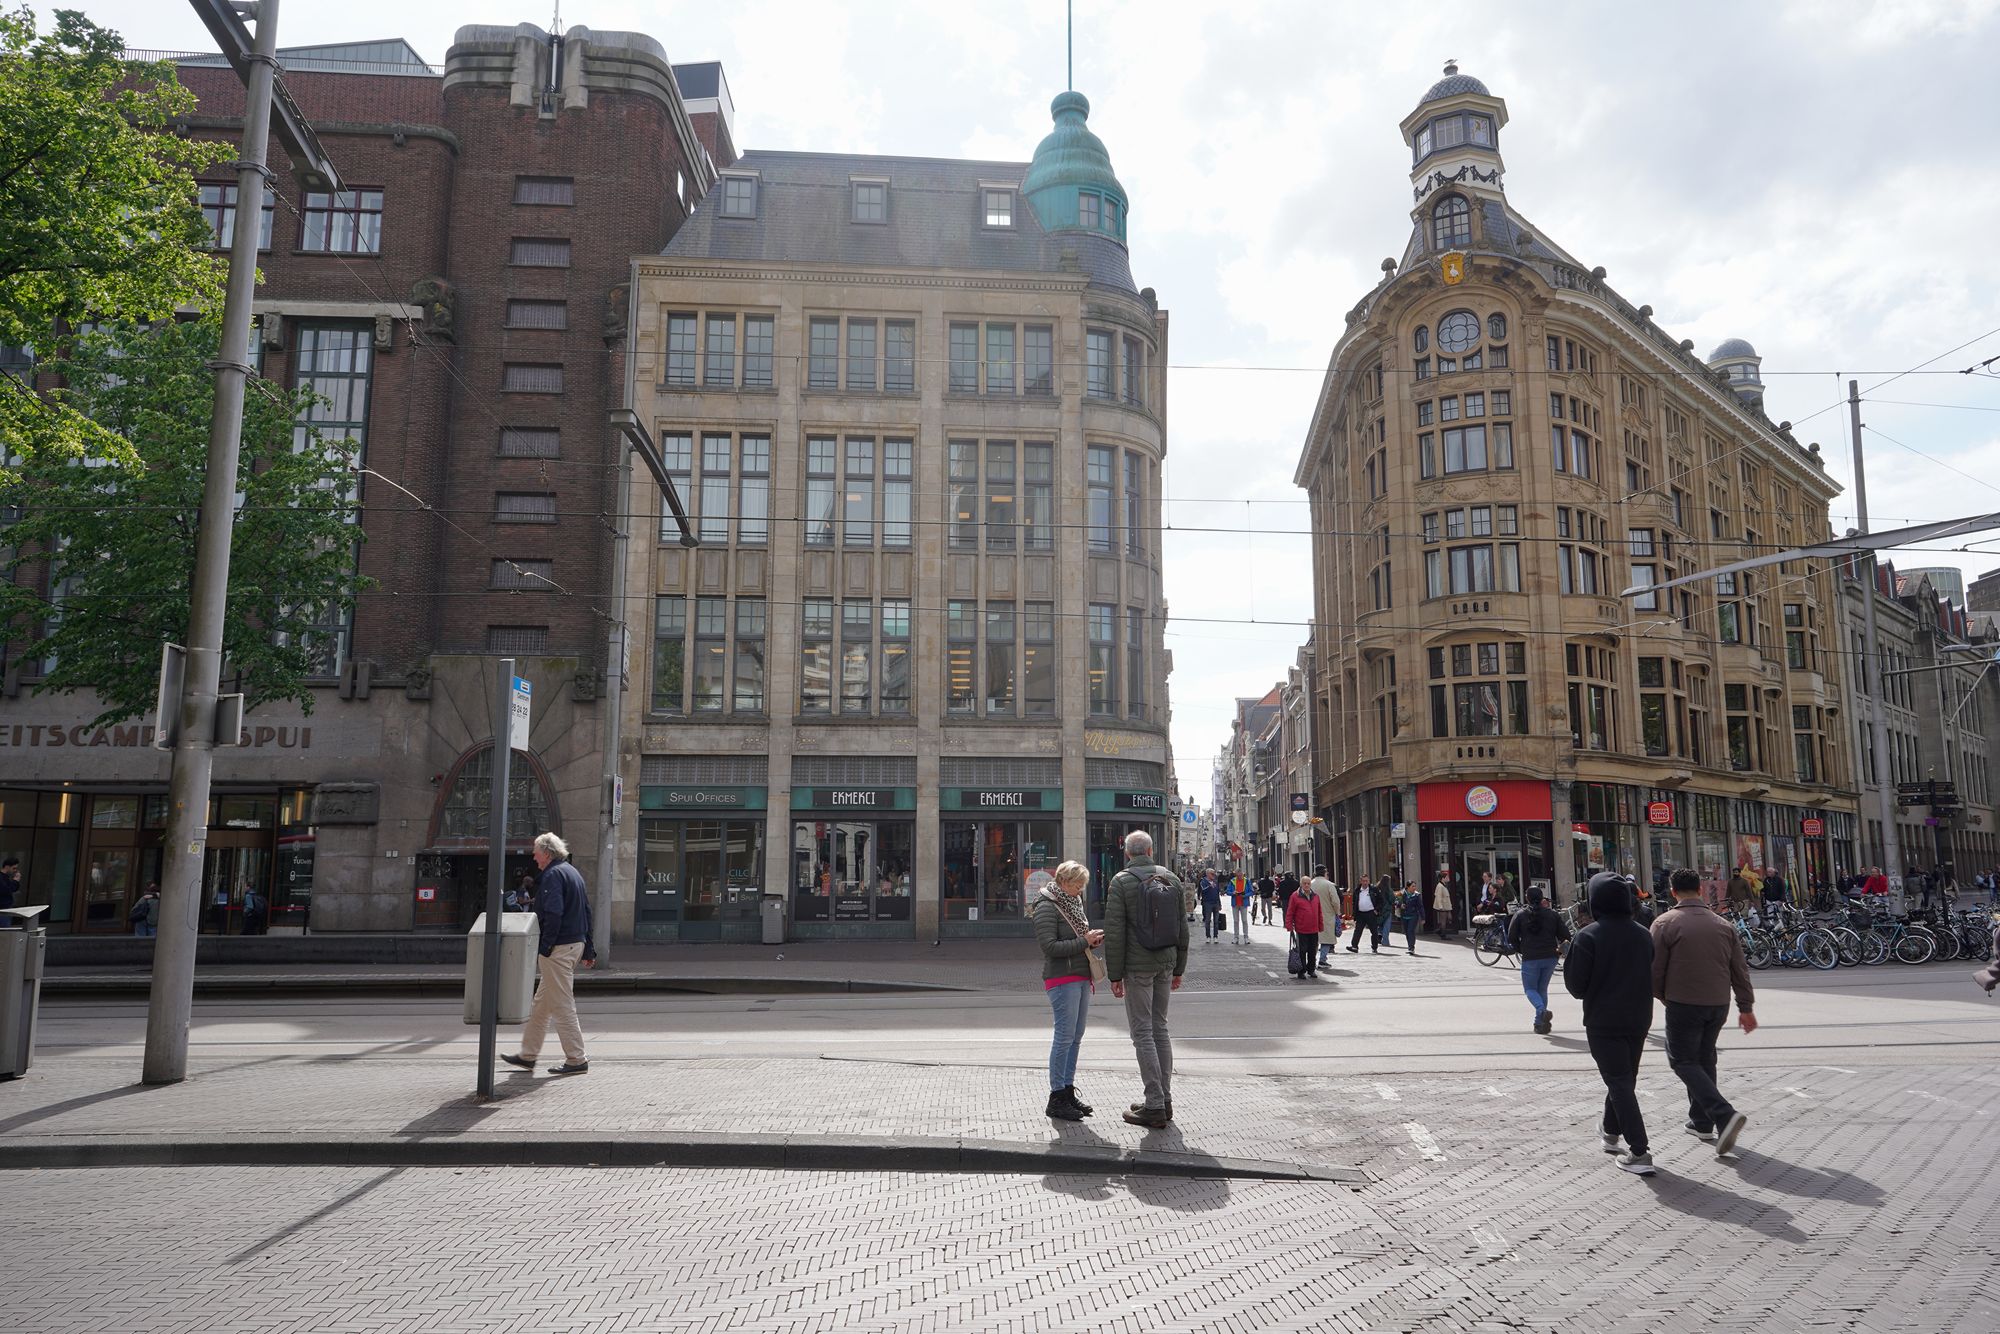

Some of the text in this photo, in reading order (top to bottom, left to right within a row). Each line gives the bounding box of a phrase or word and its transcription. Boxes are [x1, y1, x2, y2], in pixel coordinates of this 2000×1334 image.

[832, 791, 876, 805] EKMEKCI
[980, 792, 1023, 806] EKMEKCI
[1132, 794, 1160, 809] EKMEKCI
[1469, 790, 1492, 803] BURGER
[1470, 796, 1494, 809] KING
[647, 872, 676, 883] NRC
